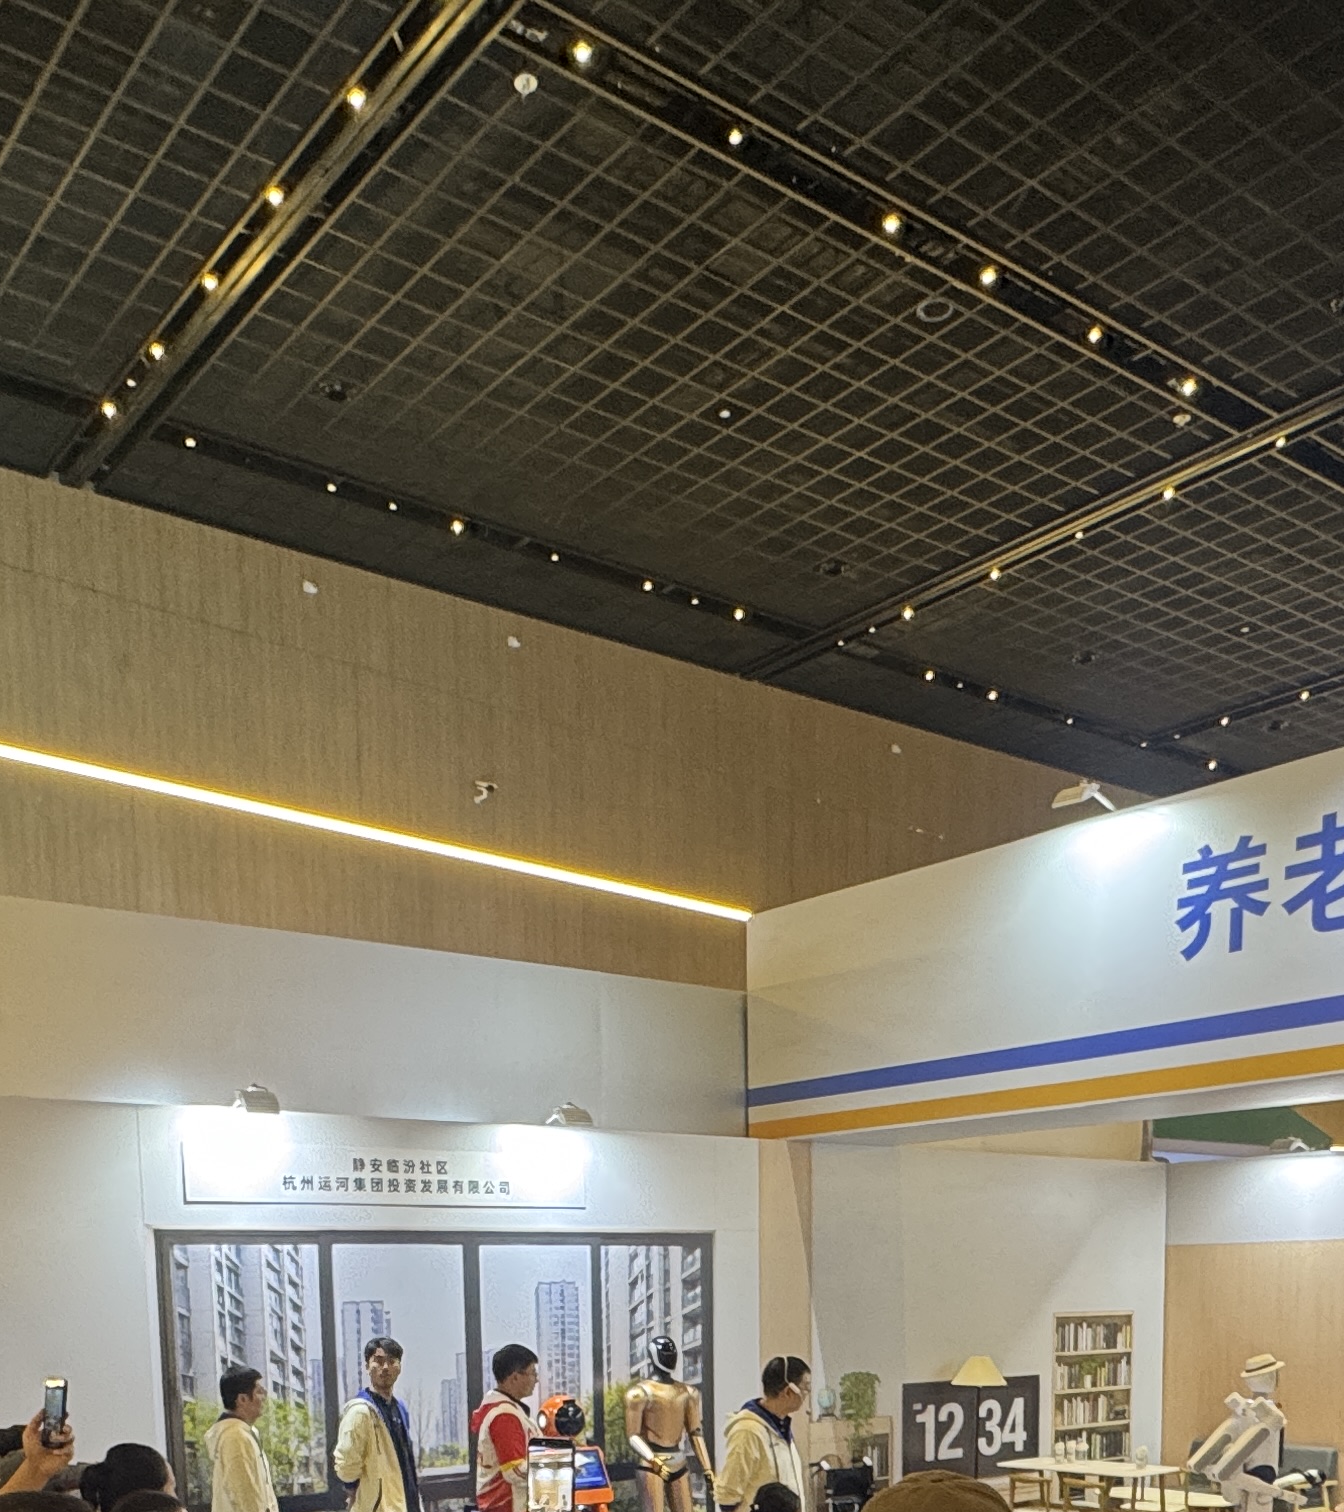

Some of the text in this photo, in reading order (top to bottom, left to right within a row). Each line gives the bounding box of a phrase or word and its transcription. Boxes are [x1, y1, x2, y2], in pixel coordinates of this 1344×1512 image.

[352, 1157, 449, 1176] 静安临汾社区
[281, 1174, 511, 1196] 杭州运河集团投资发展有限公司
[914, 1396, 1028, 1463] 12 34
